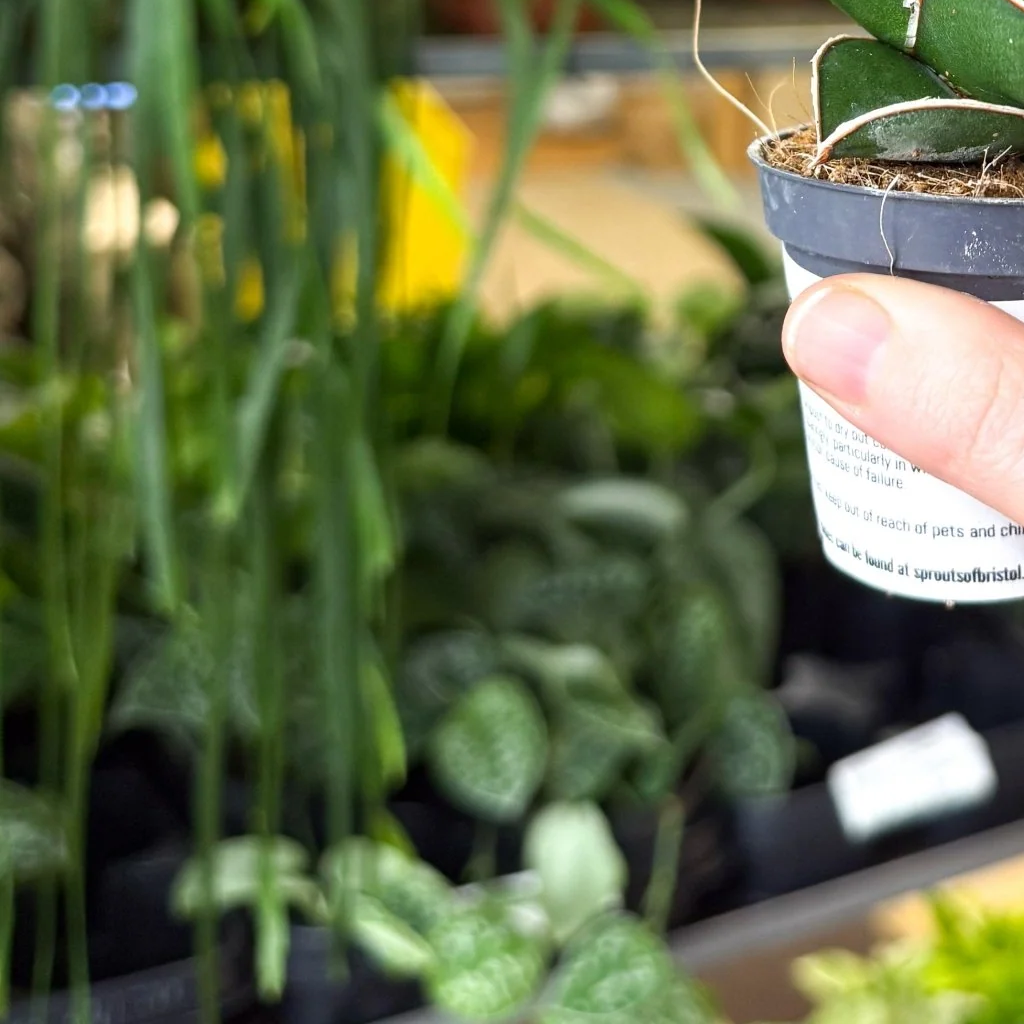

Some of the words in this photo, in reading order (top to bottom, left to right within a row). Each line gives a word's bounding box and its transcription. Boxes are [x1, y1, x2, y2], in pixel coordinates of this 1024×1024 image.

[835, 423, 850, 439] dry
[852, 430, 869, 445] out
[826, 450, 851, 473] cause
[853, 464, 863, 478] of
[866, 467, 904, 490] failure
[833, 438, 893, 472] particularly
[895, 460, 907, 472] in
[844, 501, 860, 518] out
[863, 509, 873, 522] of
[877, 514, 911, 533] reach
[914, 521, 928, 535] of
[932, 524, 965, 540] pets
[970, 523, 996, 538] and
[865, 549, 894, 573] found
[898, 562, 910, 577] at
